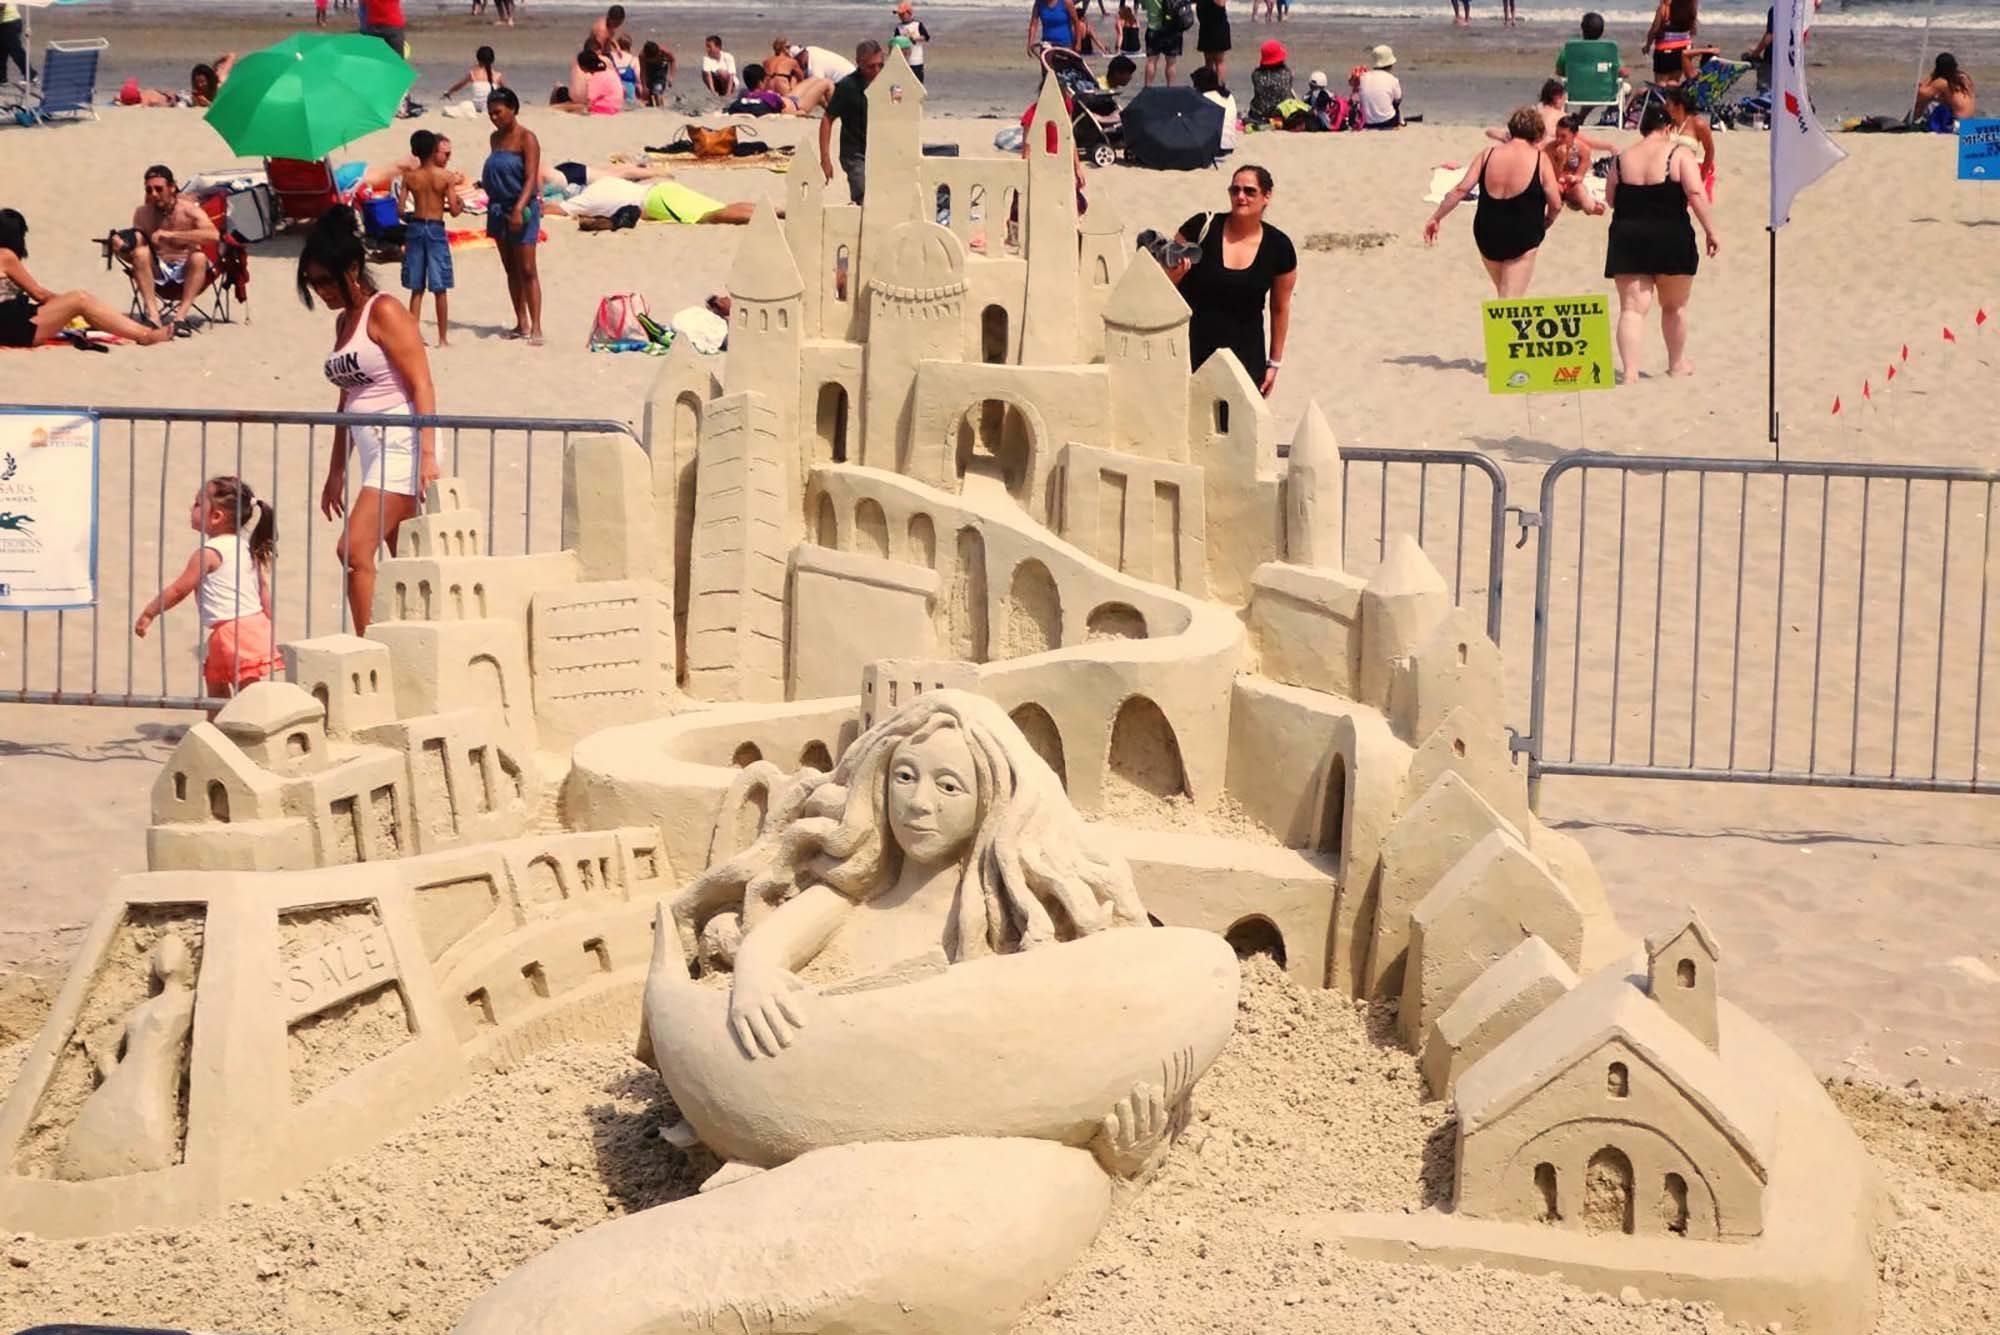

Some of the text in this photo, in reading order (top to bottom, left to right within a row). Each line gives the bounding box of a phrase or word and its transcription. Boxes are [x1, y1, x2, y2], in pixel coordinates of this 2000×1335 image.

[1488, 302, 1603, 319] WHAT WILL
[1511, 317, 1582, 341] YOU
[1508, 340, 1588, 359] FIND?
[285, 934, 385, 1003] SALE
